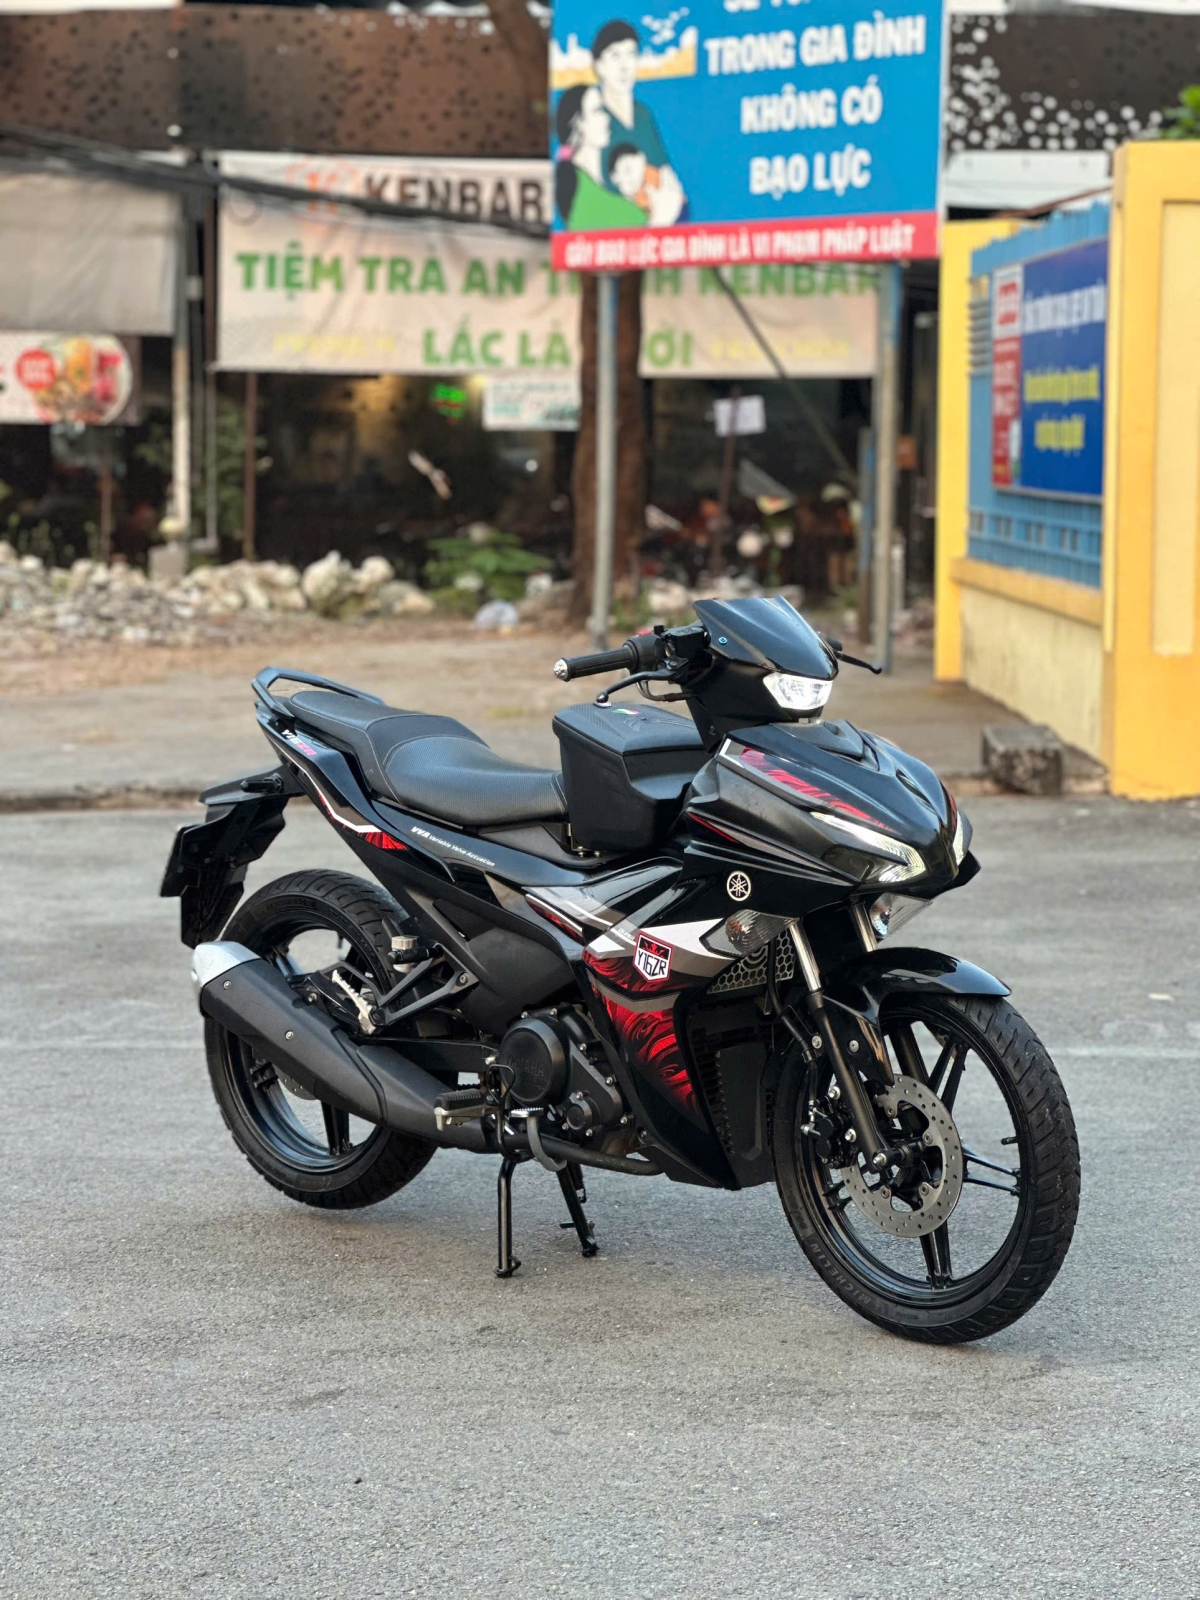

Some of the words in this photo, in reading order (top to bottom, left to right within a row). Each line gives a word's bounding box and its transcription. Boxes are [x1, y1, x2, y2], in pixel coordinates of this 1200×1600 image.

[704, 30, 797, 76] TRONG
[799, 23, 849, 67] GIA
[852, 9, 927, 61] ĐÌNH
[740, 82, 838, 135] KHÔNG
[840, 74, 884, 127] CÓ
[749, 152, 809, 200] BẠO
[813, 142, 872, 197] LỰC
[364, 173, 543, 225] KENBAR
[868, 217, 916, 258] LUẬT
[234, 239, 344, 300] TIỆM
[461, 258, 525, 298] AN
[281, 729, 317, 756] Y16ZR
[410, 826, 431, 839] VVA
[428, 835, 452, 849] Variable
[451, 844, 467, 855] Valve
[465, 851, 496, 867] Actuation
[637, 948, 668, 978] Y16ZR
[810, 1241, 872, 1305] MICHELIN
